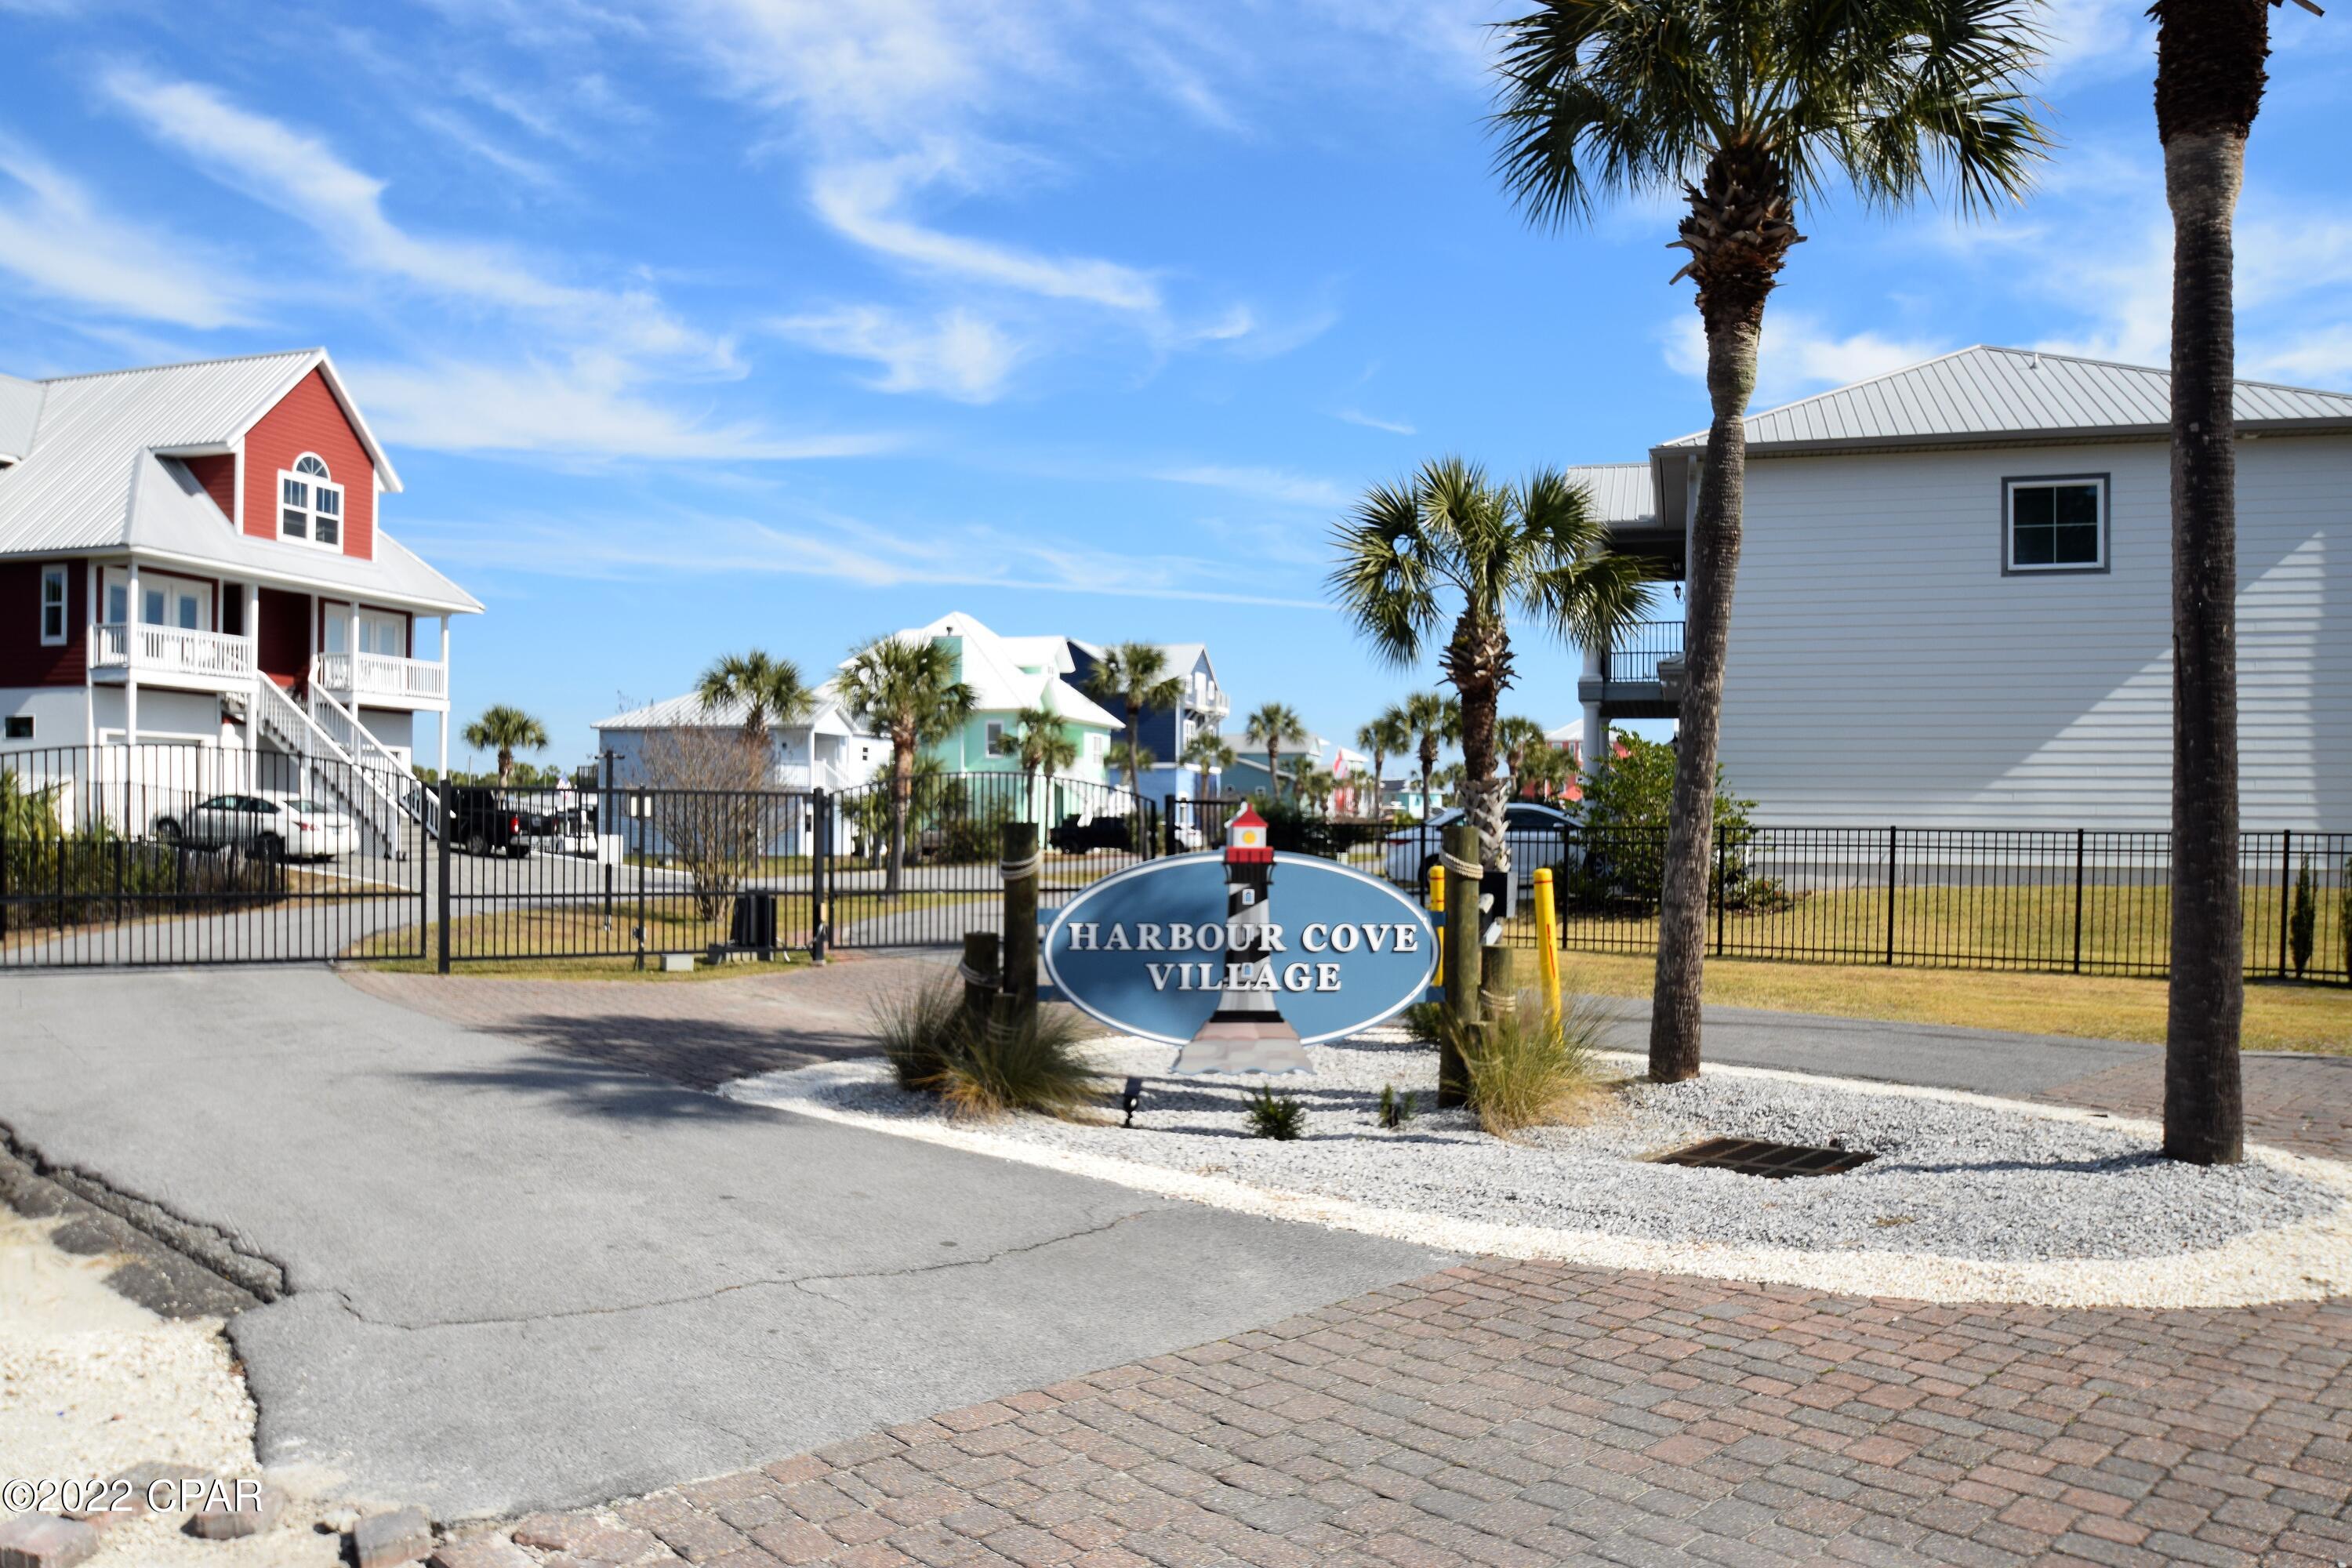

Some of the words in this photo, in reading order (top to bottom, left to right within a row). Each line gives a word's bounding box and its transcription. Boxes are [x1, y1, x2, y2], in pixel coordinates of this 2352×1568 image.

[1067, 922, 1288, 952] HARBOUR
[1301, 923, 1419, 953] COVE
[1145, 962, 1342, 992] VILLAGE
